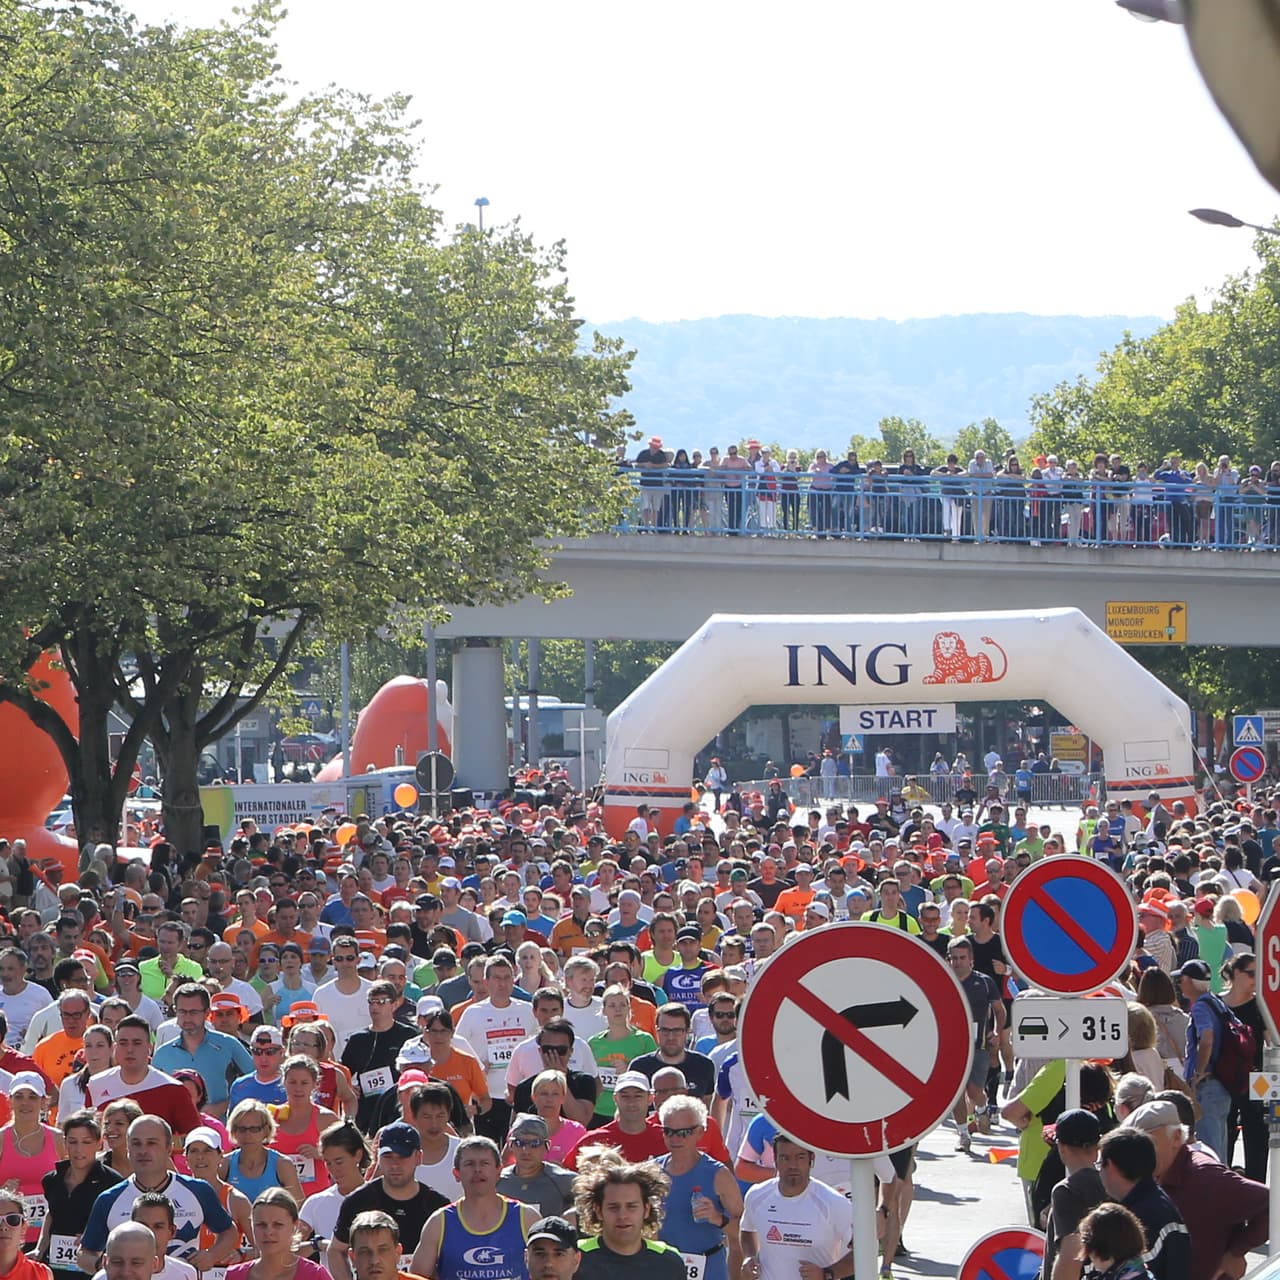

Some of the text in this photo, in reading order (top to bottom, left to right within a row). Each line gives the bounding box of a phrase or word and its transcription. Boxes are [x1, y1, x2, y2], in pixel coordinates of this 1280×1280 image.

[783, 643, 912, 687] ING
[859, 709, 938, 731] START
[623, 772, 649, 783] ING
[1126, 767, 1152, 777] ING
[234, 800, 307, 812] INTERNATIONALER
[367, 1075, 385, 1089] 195
[456, 1268, 513, 1278] GUARDIAN
